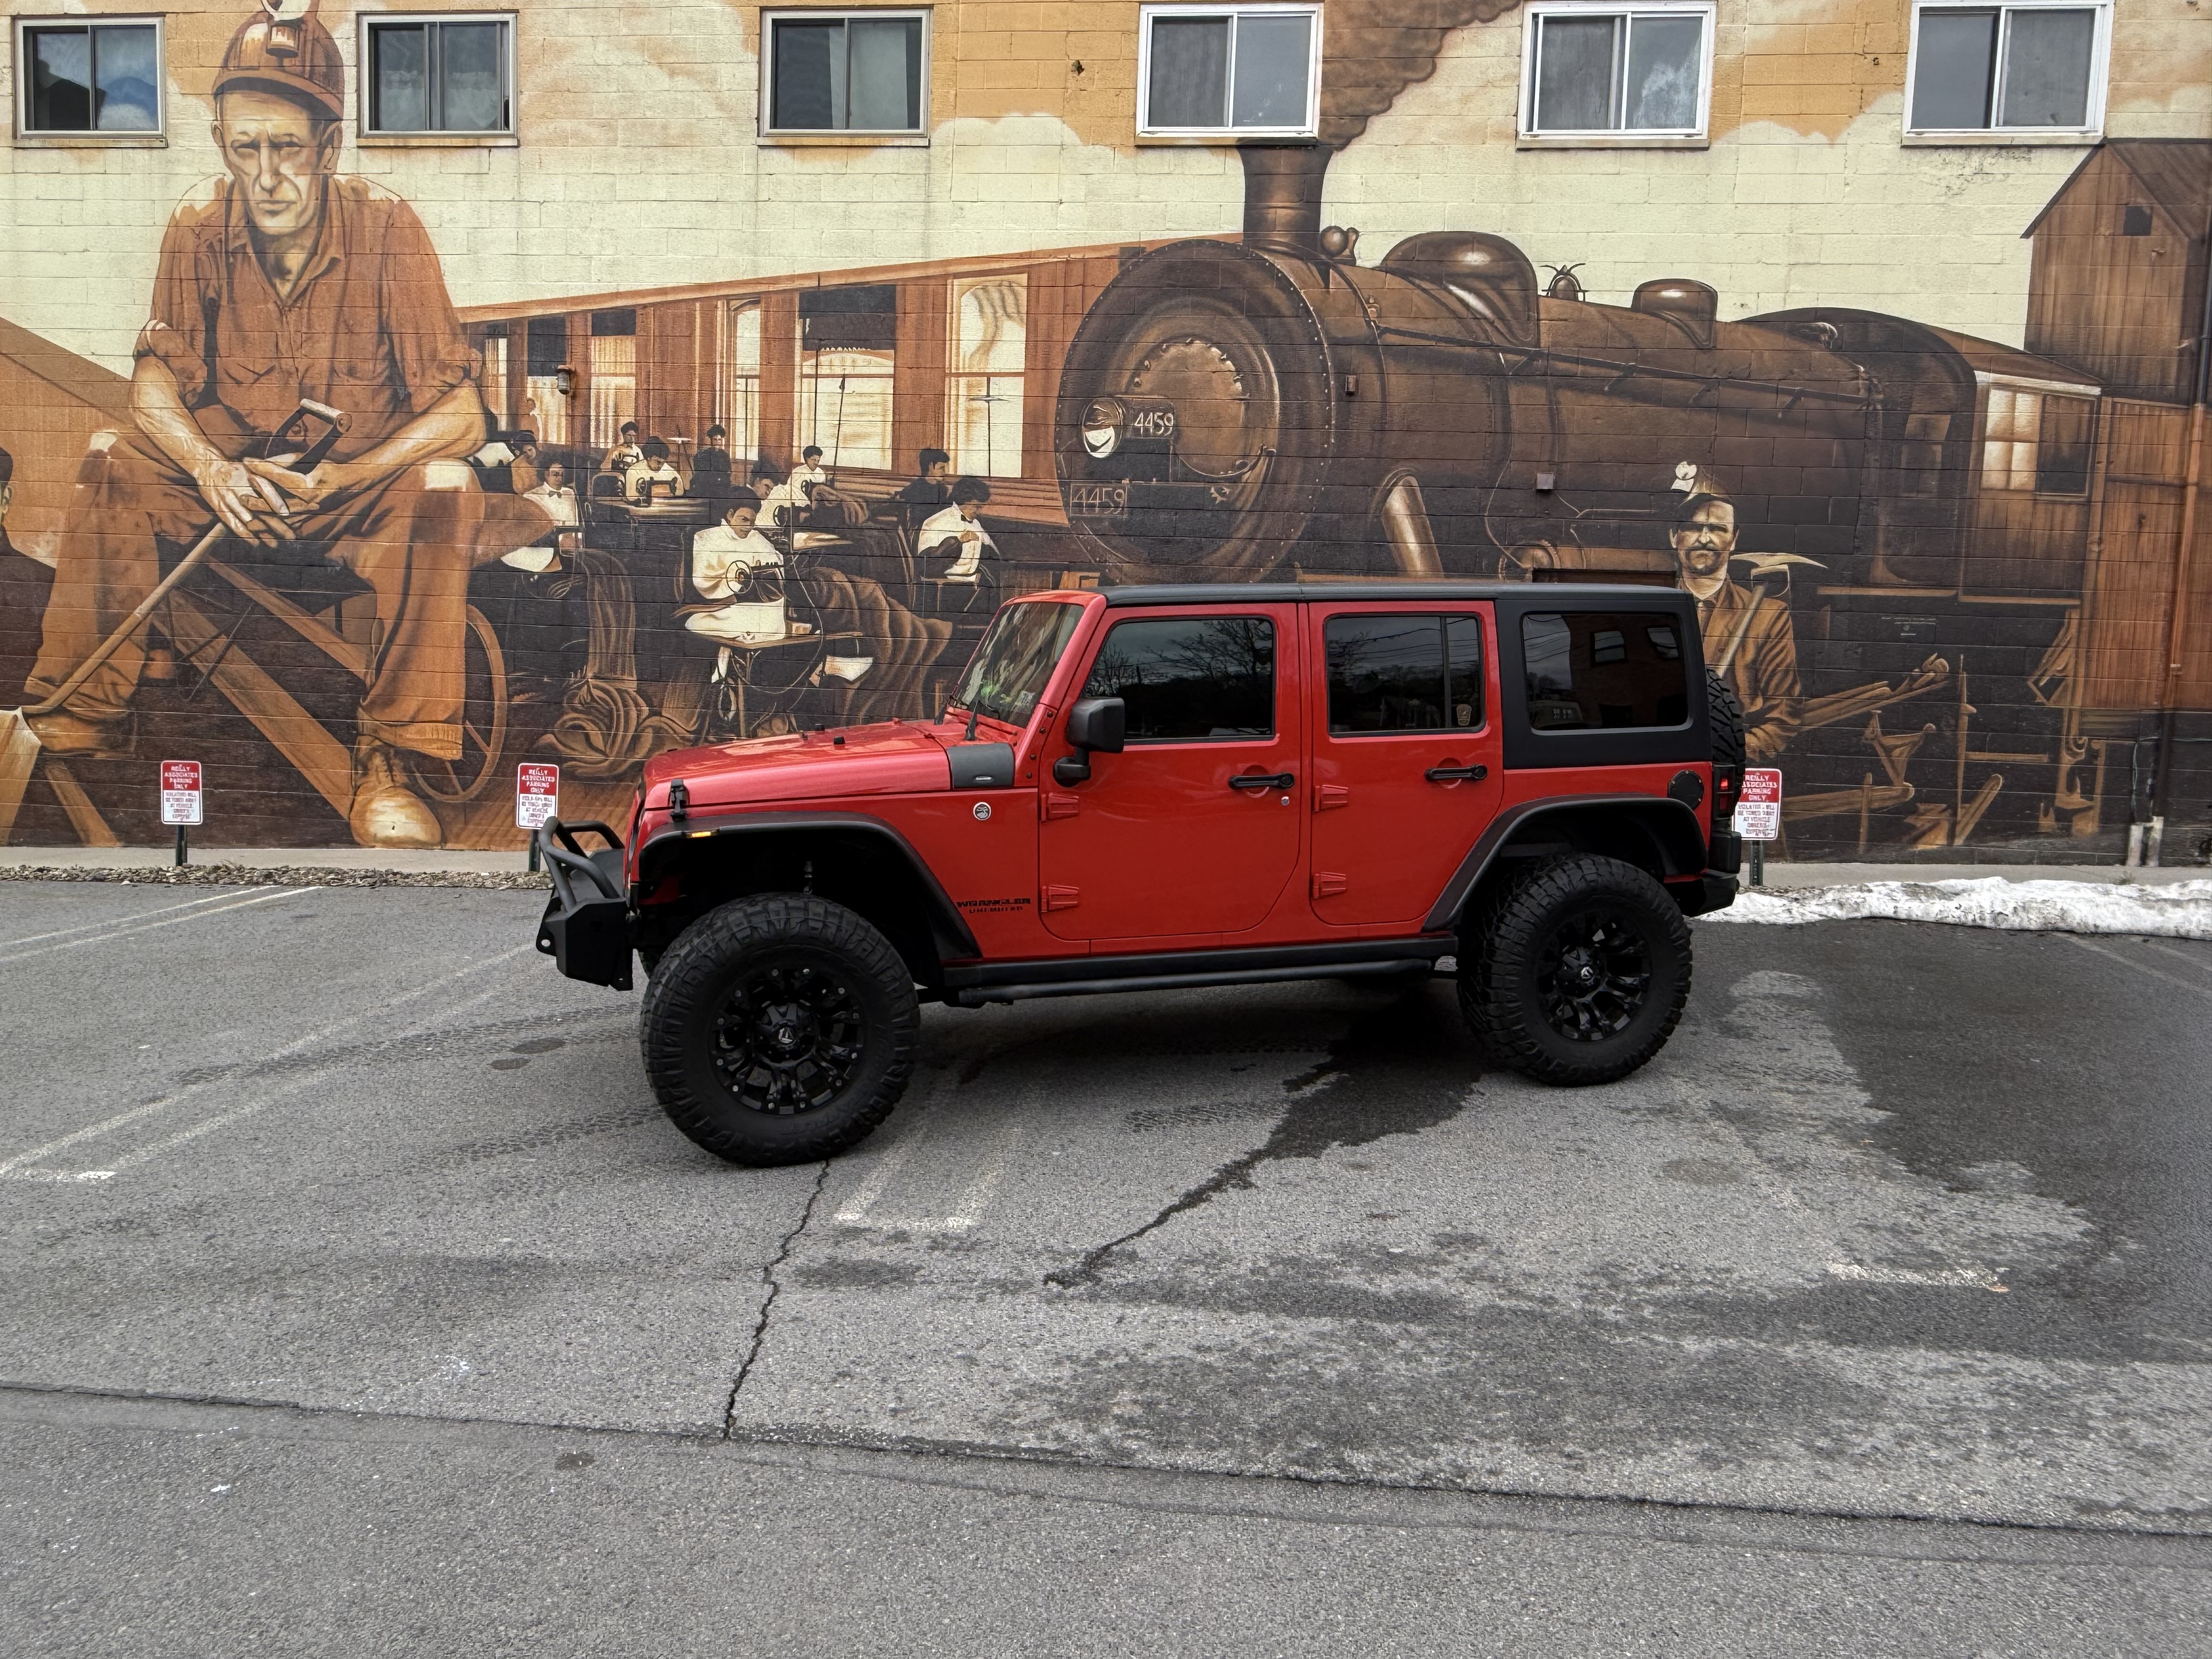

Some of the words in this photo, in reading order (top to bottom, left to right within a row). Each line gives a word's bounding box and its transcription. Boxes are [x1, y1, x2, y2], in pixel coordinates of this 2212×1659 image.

[1134, 411, 1174, 436] 4459
[1071, 487, 1125, 515] 4459
[956, 898, 1031, 908] WRANGLER
